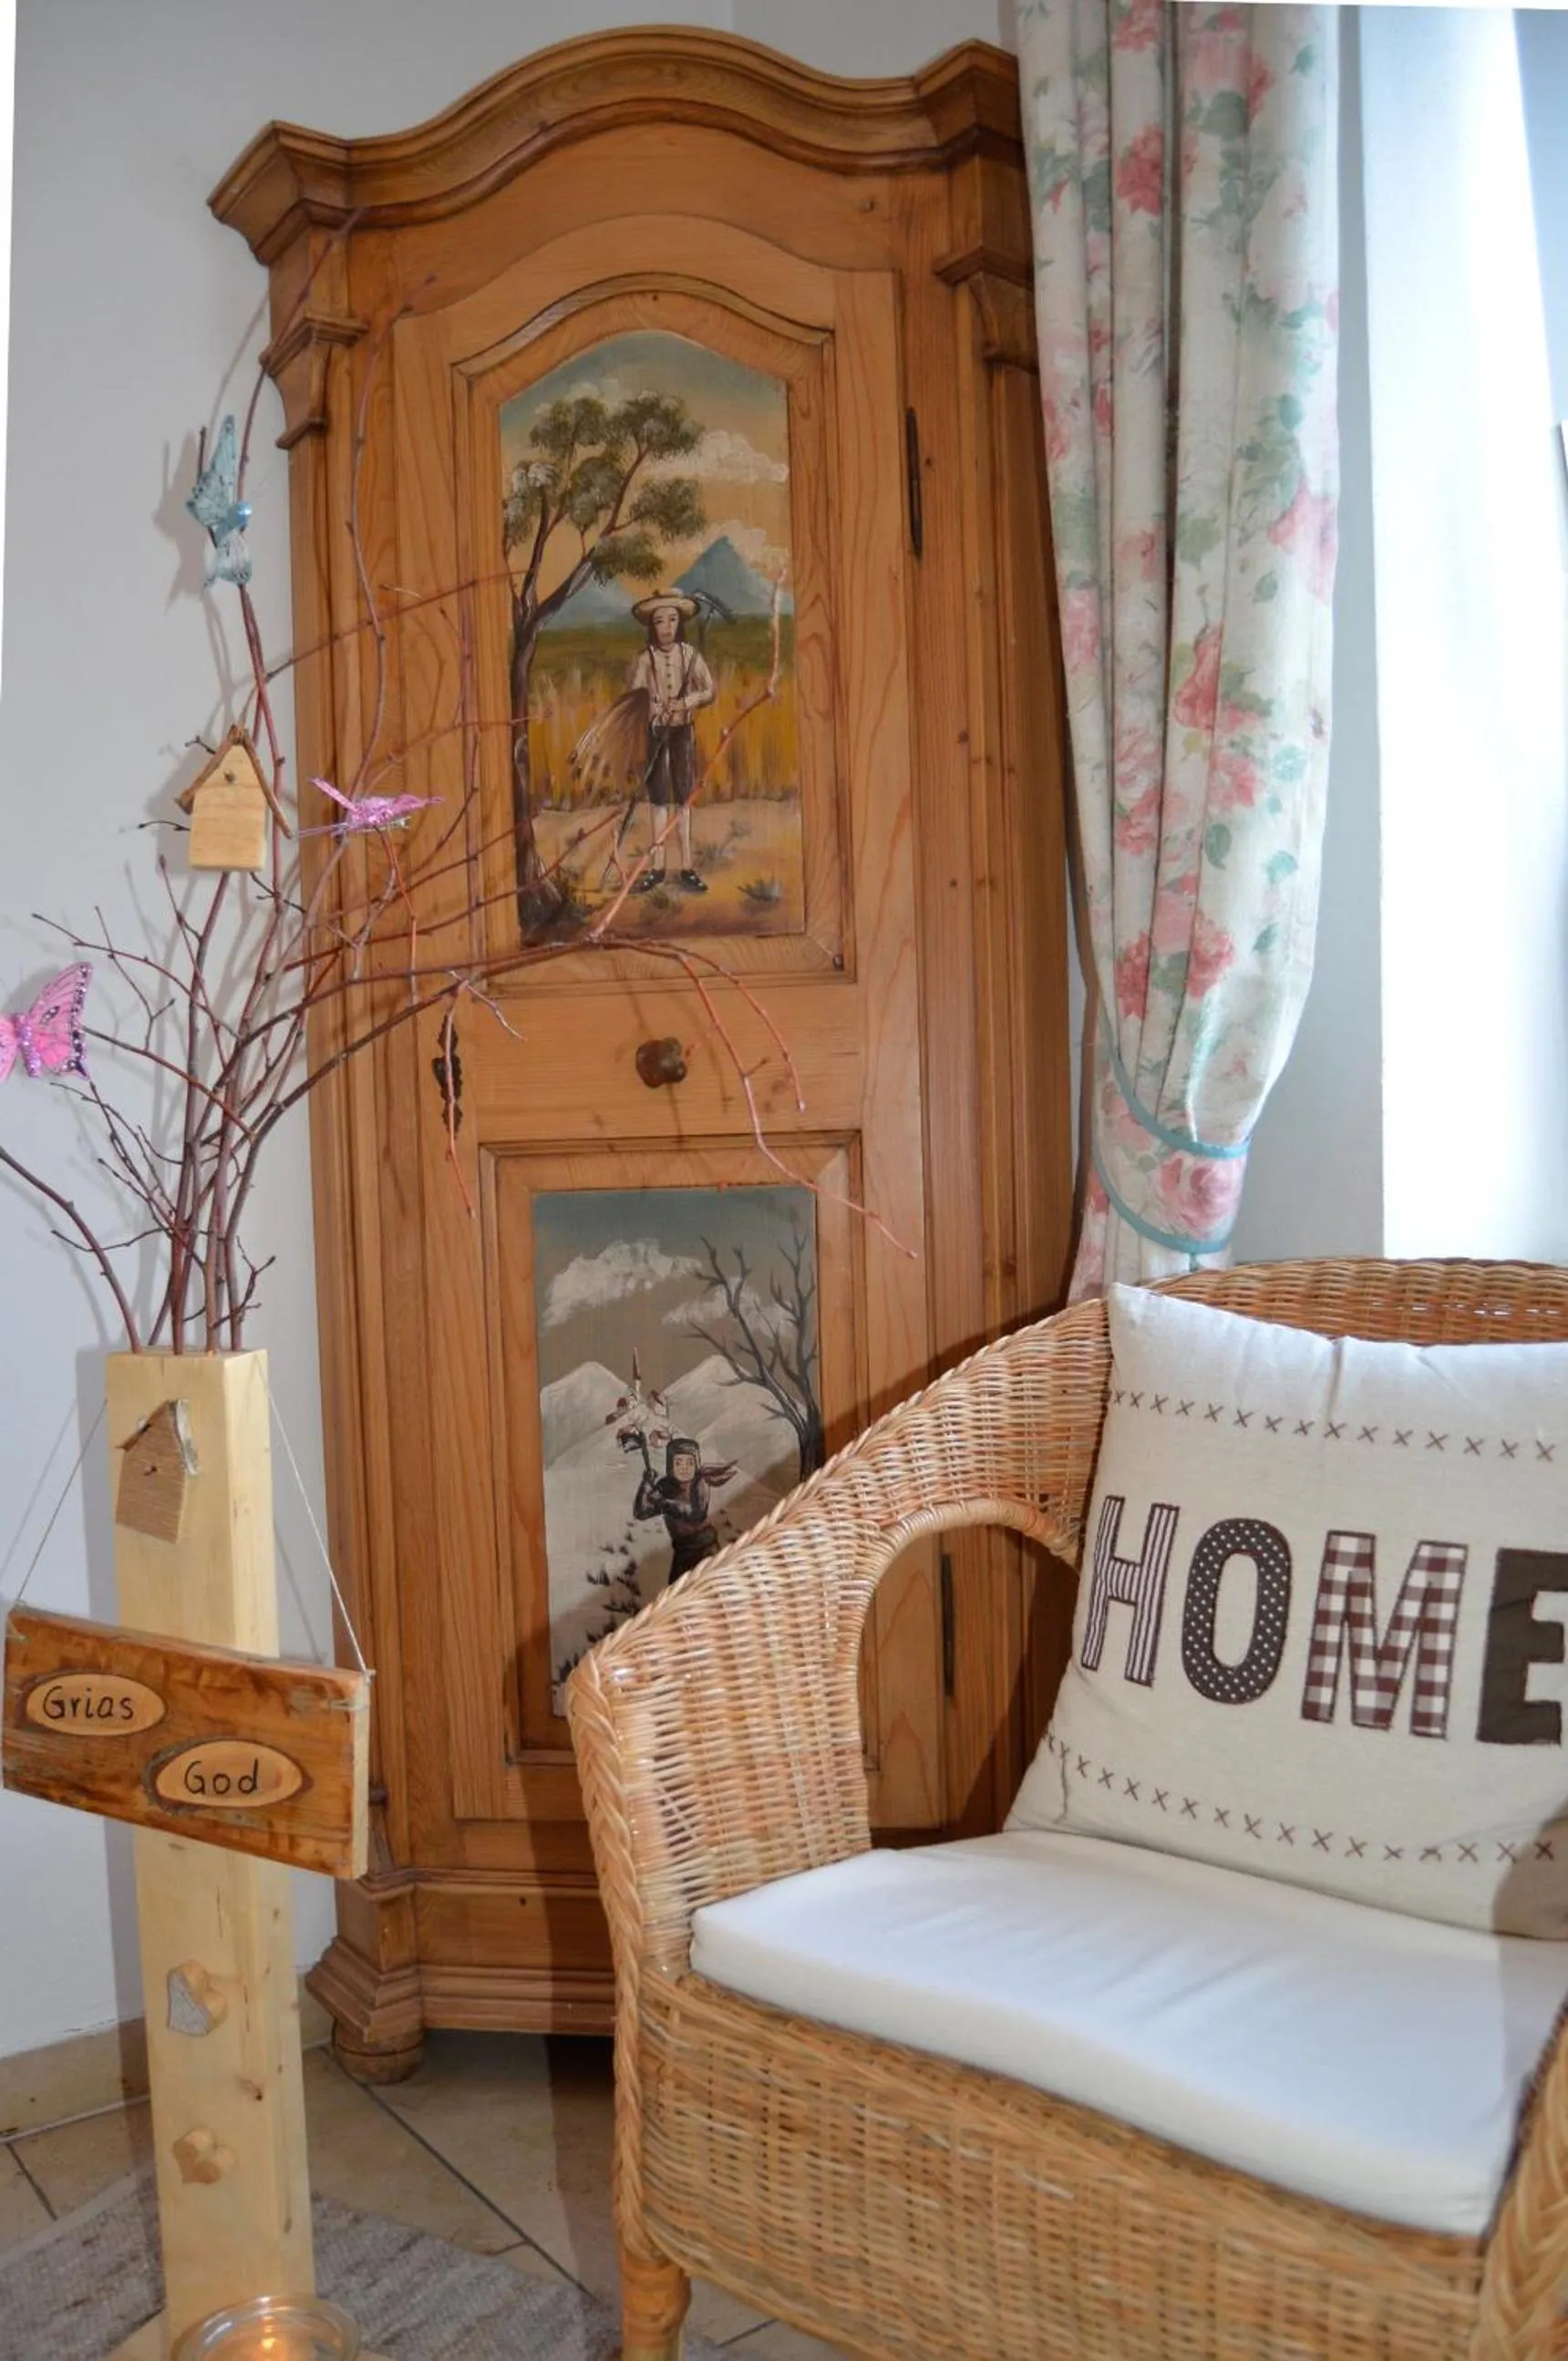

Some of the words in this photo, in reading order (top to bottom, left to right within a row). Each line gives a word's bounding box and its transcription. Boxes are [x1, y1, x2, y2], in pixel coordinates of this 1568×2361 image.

[1081, 1495, 1568, 1746] HOME
[42, 1685, 135, 1720] Grias
[184, 1758, 260, 1795] God
